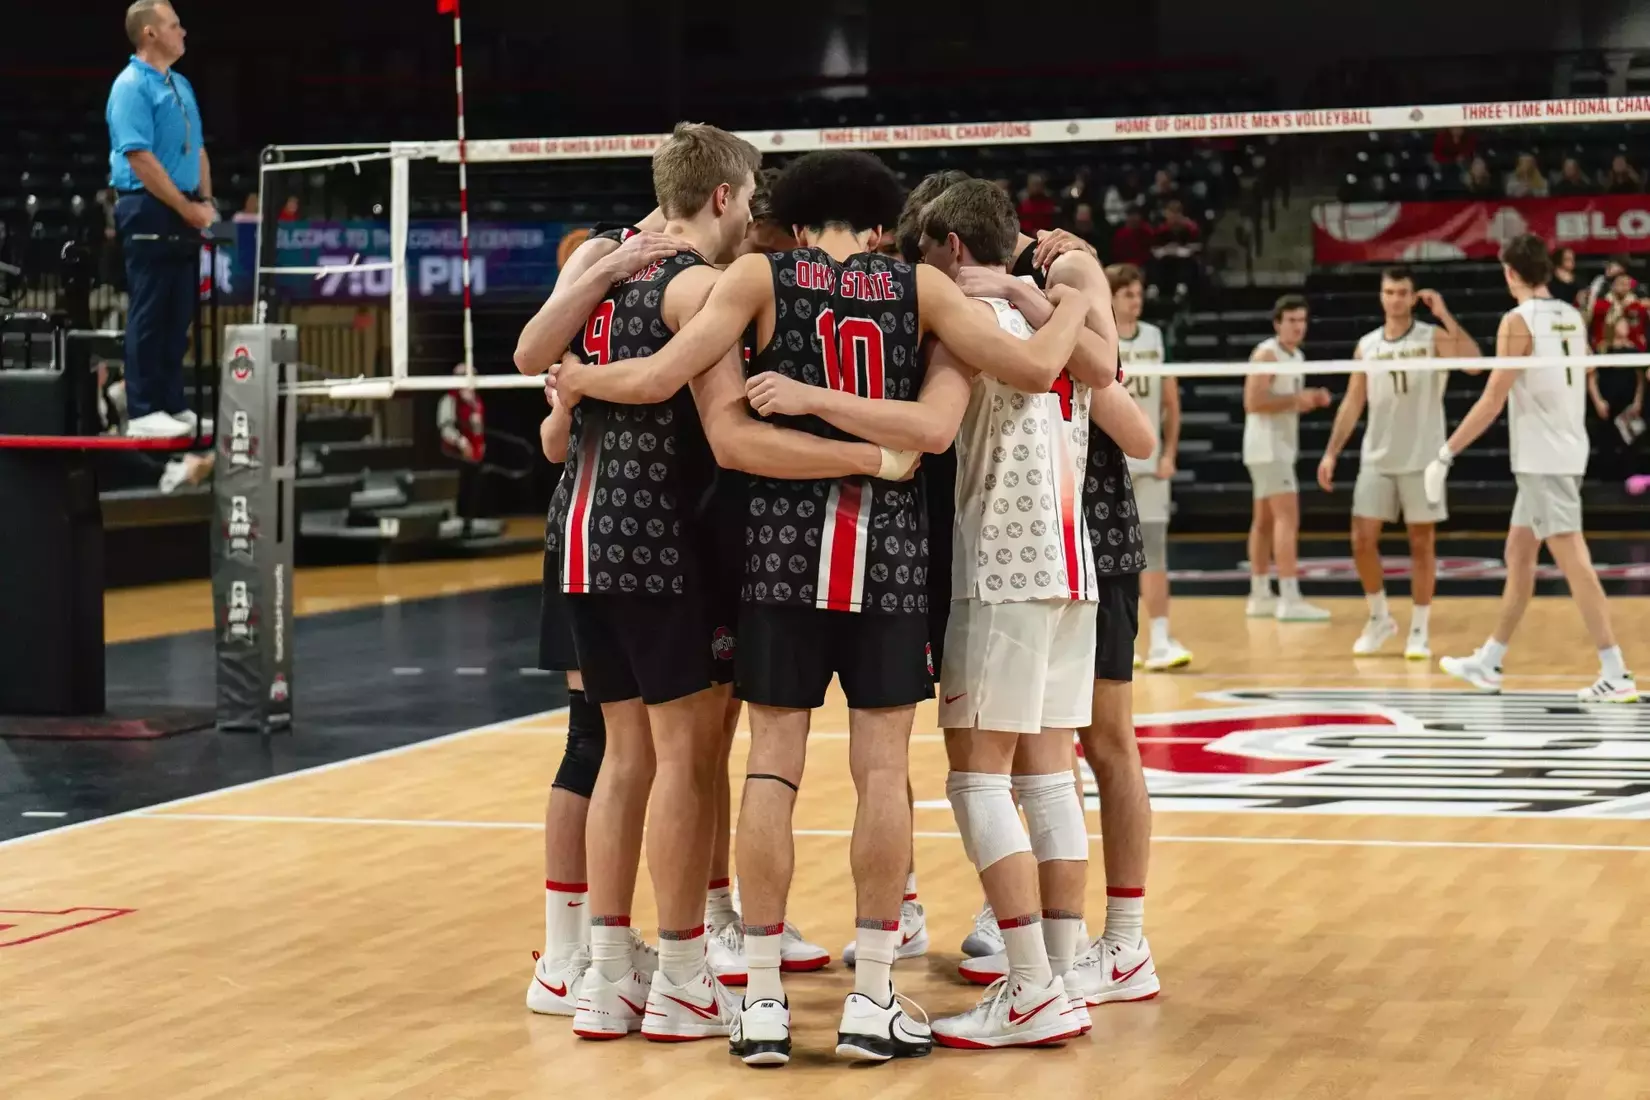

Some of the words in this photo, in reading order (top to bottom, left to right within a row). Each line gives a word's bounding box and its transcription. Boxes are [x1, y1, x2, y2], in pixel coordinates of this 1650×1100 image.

[1115, 119, 1151, 133] HOME
[1155, 118, 1170, 132] OF
[1174, 117, 1207, 132] OHIO
[1210, 115, 1247, 130] STATE
[1251, 113, 1292, 128] MEN'S
[1296, 109, 1372, 127] VOLLEYBALL
[1462, 102, 1542, 120] THREE-TIME
[1546, 99, 1612, 116] NATIONAL
[893, 125, 952, 141] NATIONAL
[956, 122, 1032, 139] CHAMPIONS
[418, 255, 487, 297] PM
[841, 270, 896, 302] STATE
[583, 298, 616, 366] 9
[815, 307, 886, 400] 10
